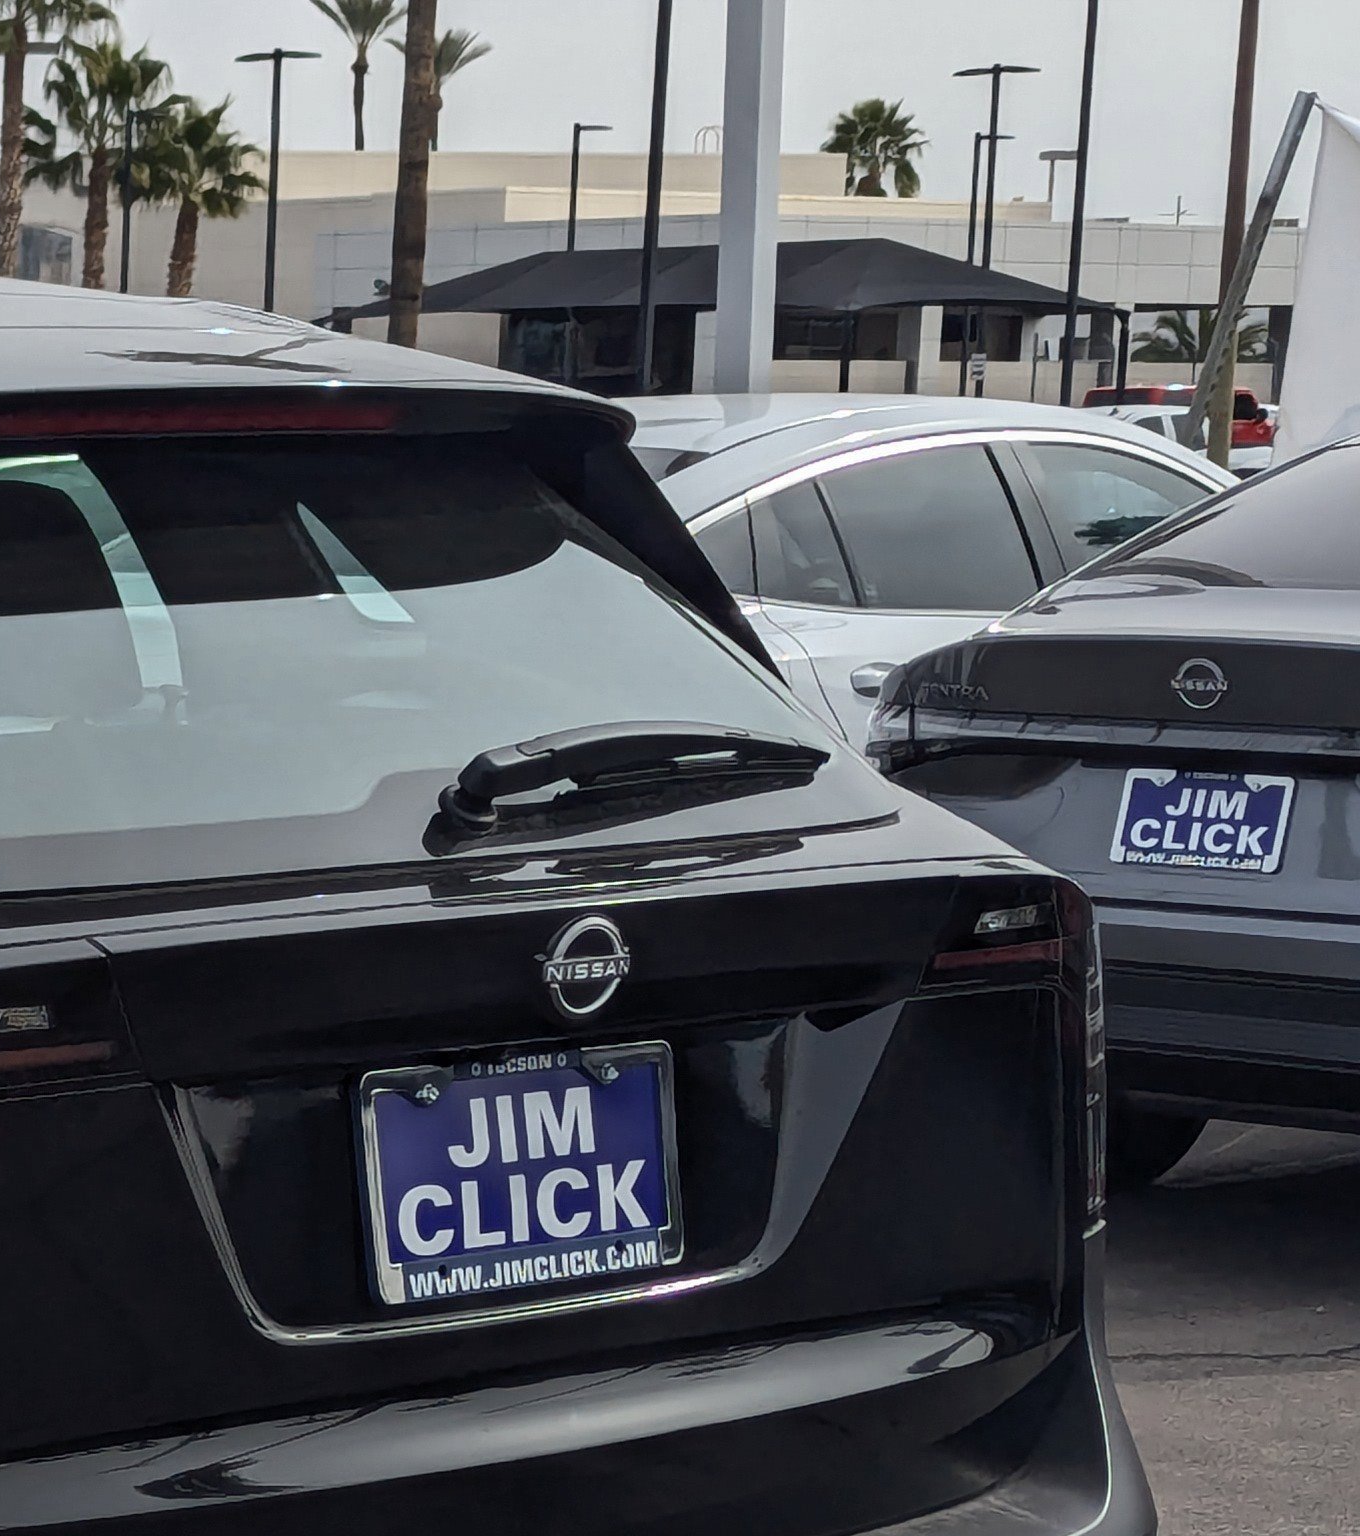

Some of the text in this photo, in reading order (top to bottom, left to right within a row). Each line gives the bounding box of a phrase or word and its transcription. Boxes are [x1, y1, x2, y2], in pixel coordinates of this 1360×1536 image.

[1165, 788, 1249, 820] JIM
[1130, 818, 1269, 856] CLICK
[546, 959, 630, 982] NISSAN
[448, 1086, 596, 1168] JIM
[398, 1159, 651, 1256] CLICK
[409, 1240, 658, 1299] WWW.JIMCLICK.COM
